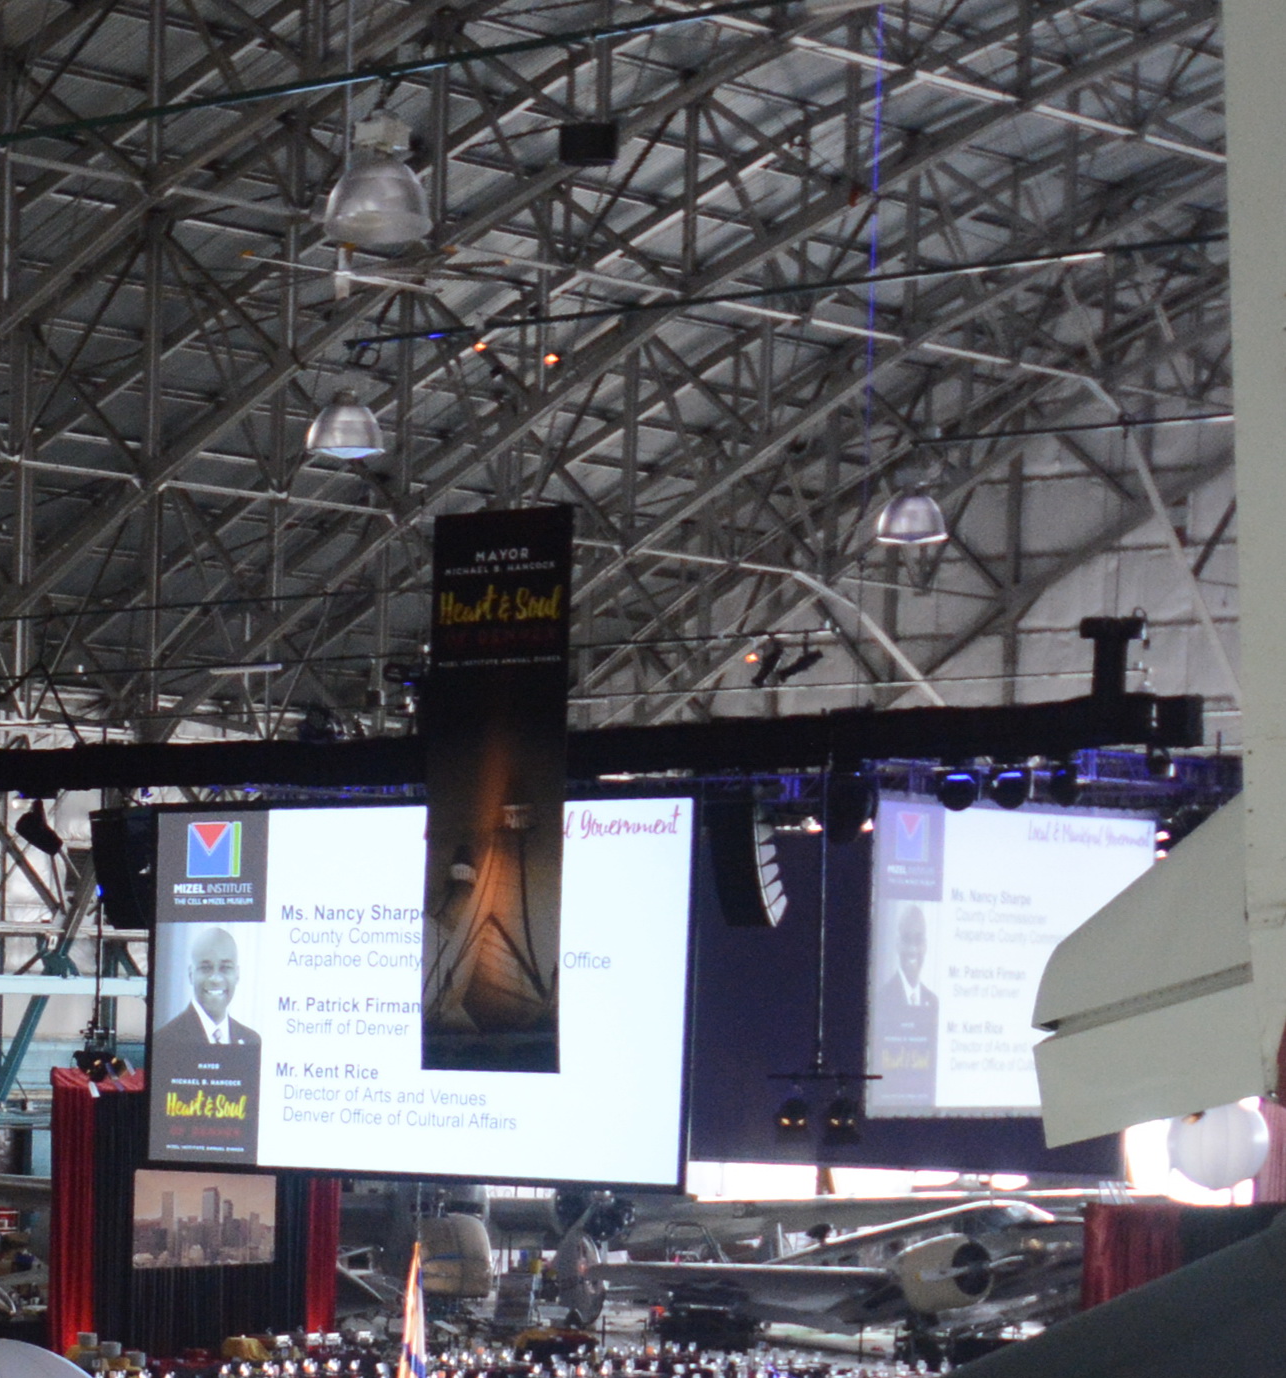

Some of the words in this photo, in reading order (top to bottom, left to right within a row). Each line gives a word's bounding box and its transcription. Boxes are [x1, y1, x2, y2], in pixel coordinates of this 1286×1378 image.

[475, 547, 529, 562] MAYOR
[445, 566, 489, 577] MICHAEL
[507, 560, 556, 572] HANCOCK
[439, 584, 498, 625] Heart
[497, 590, 511, 622] &
[515, 584, 563, 621] Soul
[580, 804, 682, 840] Government
[173, 883, 206, 894] MIZEL
[207, 882, 253, 894] INSTITUTE
[281, 904, 308, 921] Ms.
[314, 904, 365, 925] Nancy
[289, 927, 343, 948] County
[349, 927, 422, 944] Commiss
[287, 951, 362, 971] Arapahoe
[367, 951, 422, 971] County
[563, 951, 611, 970] Office
[278, 996, 299, 1013] Mr.
[305, 997, 360, 1013] Patrick
[366, 998, 422, 1014] Firman
[286, 1018, 332, 1035] Sheriff
[337, 1020, 350, 1035] of
[356, 1020, 409, 1036] Denver
[276, 1062, 298, 1078] Mr.
[303, 1062, 339, 1079] Kent
[344, 1063, 379, 1080] Rice
[166, 1090, 205, 1117] Heart
[204, 1096, 213, 1118] &
[216, 1093, 246, 1120] Soul
[283, 1084, 340, 1102] Director
[345, 1086, 359, 1102] of
[363, 1087, 392, 1103] Arts
[397, 1088, 425, 1104] and
[430, 1089, 487, 1106] Venues
[283, 1106, 335, 1123] Denver
[340, 1108, 382, 1125] Office
[387, 1109, 402, 1126] of
[406, 1110, 464, 1128] Cultural
[468, 1113, 518, 1130] Affairs
